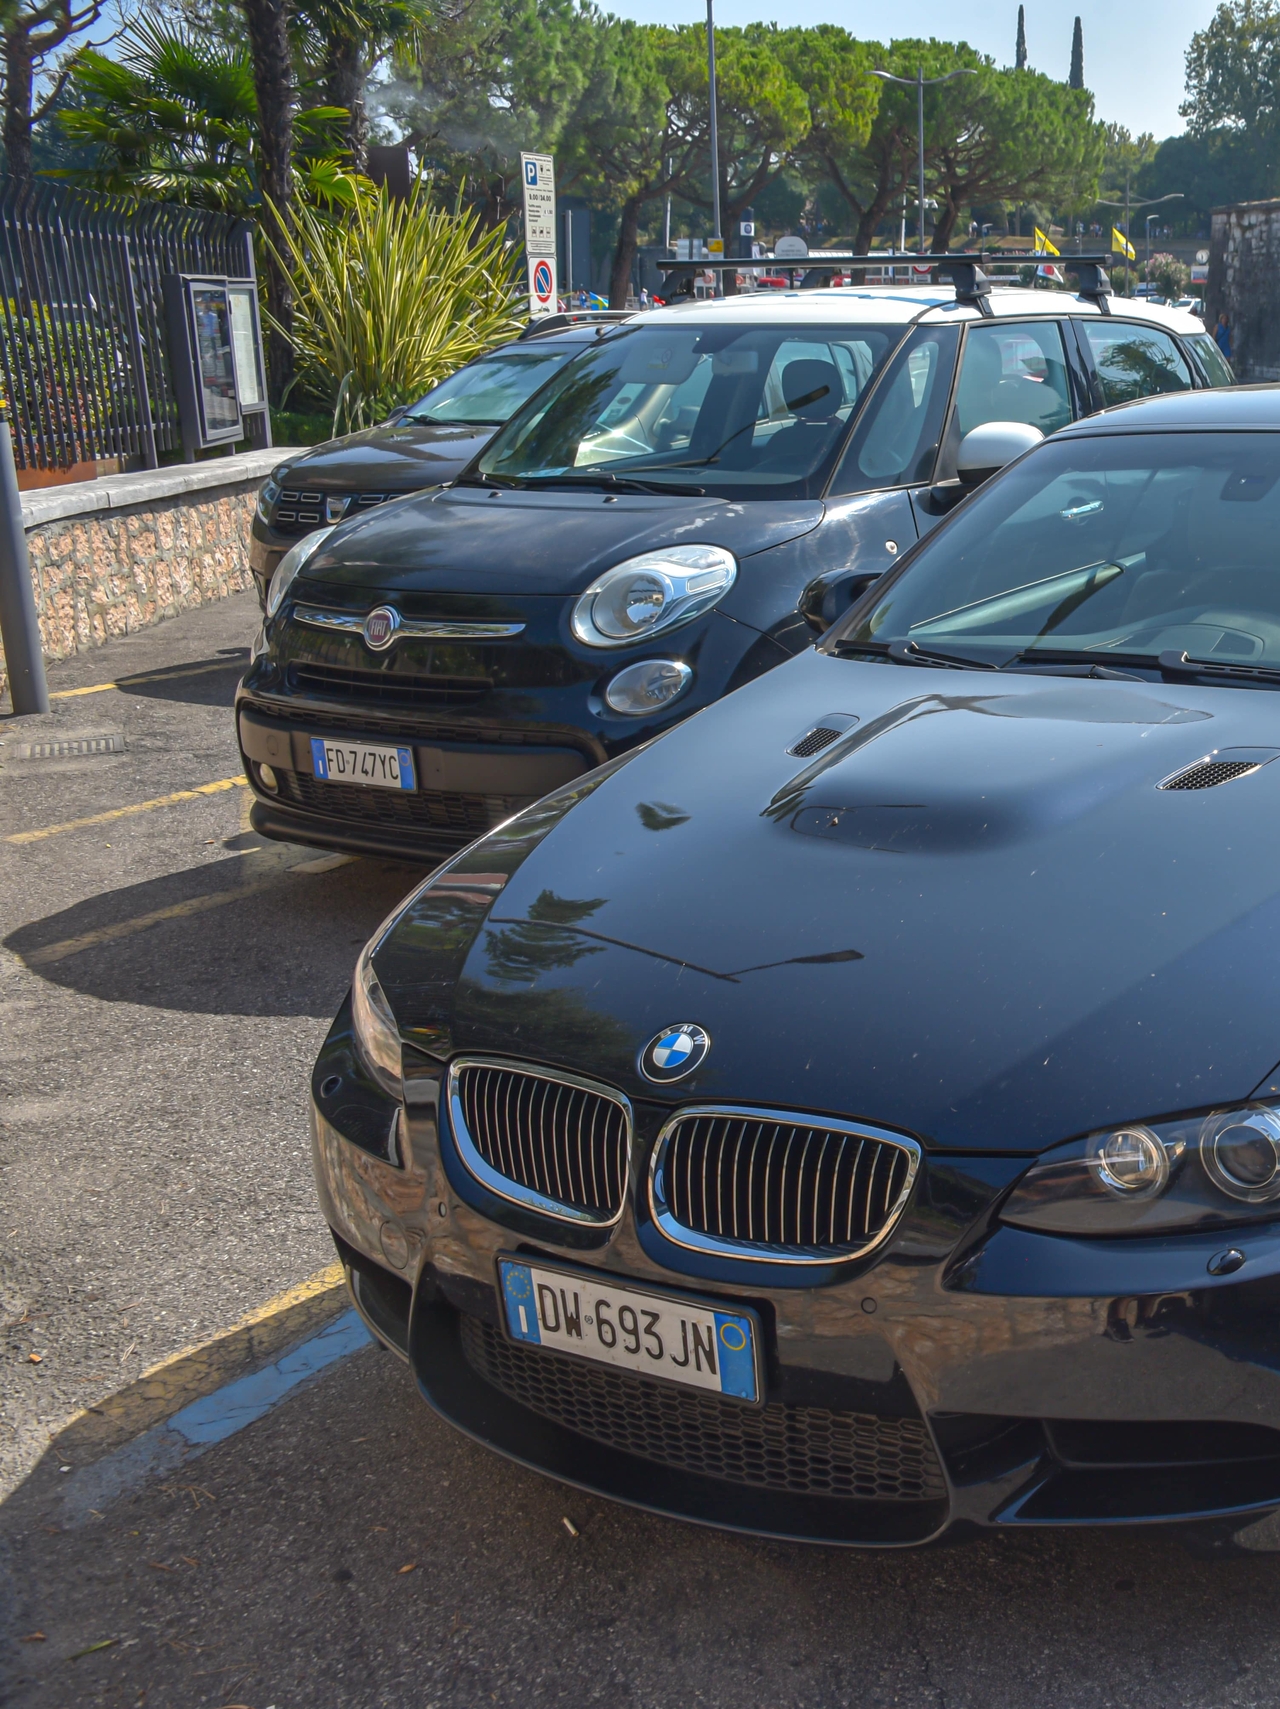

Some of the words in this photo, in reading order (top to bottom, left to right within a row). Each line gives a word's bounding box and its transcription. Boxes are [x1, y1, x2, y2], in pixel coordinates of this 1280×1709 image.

[527, 163, 535, 183] P
[370, 619, 388, 636] FIAT
[660, 1025, 706, 1045] BMW
